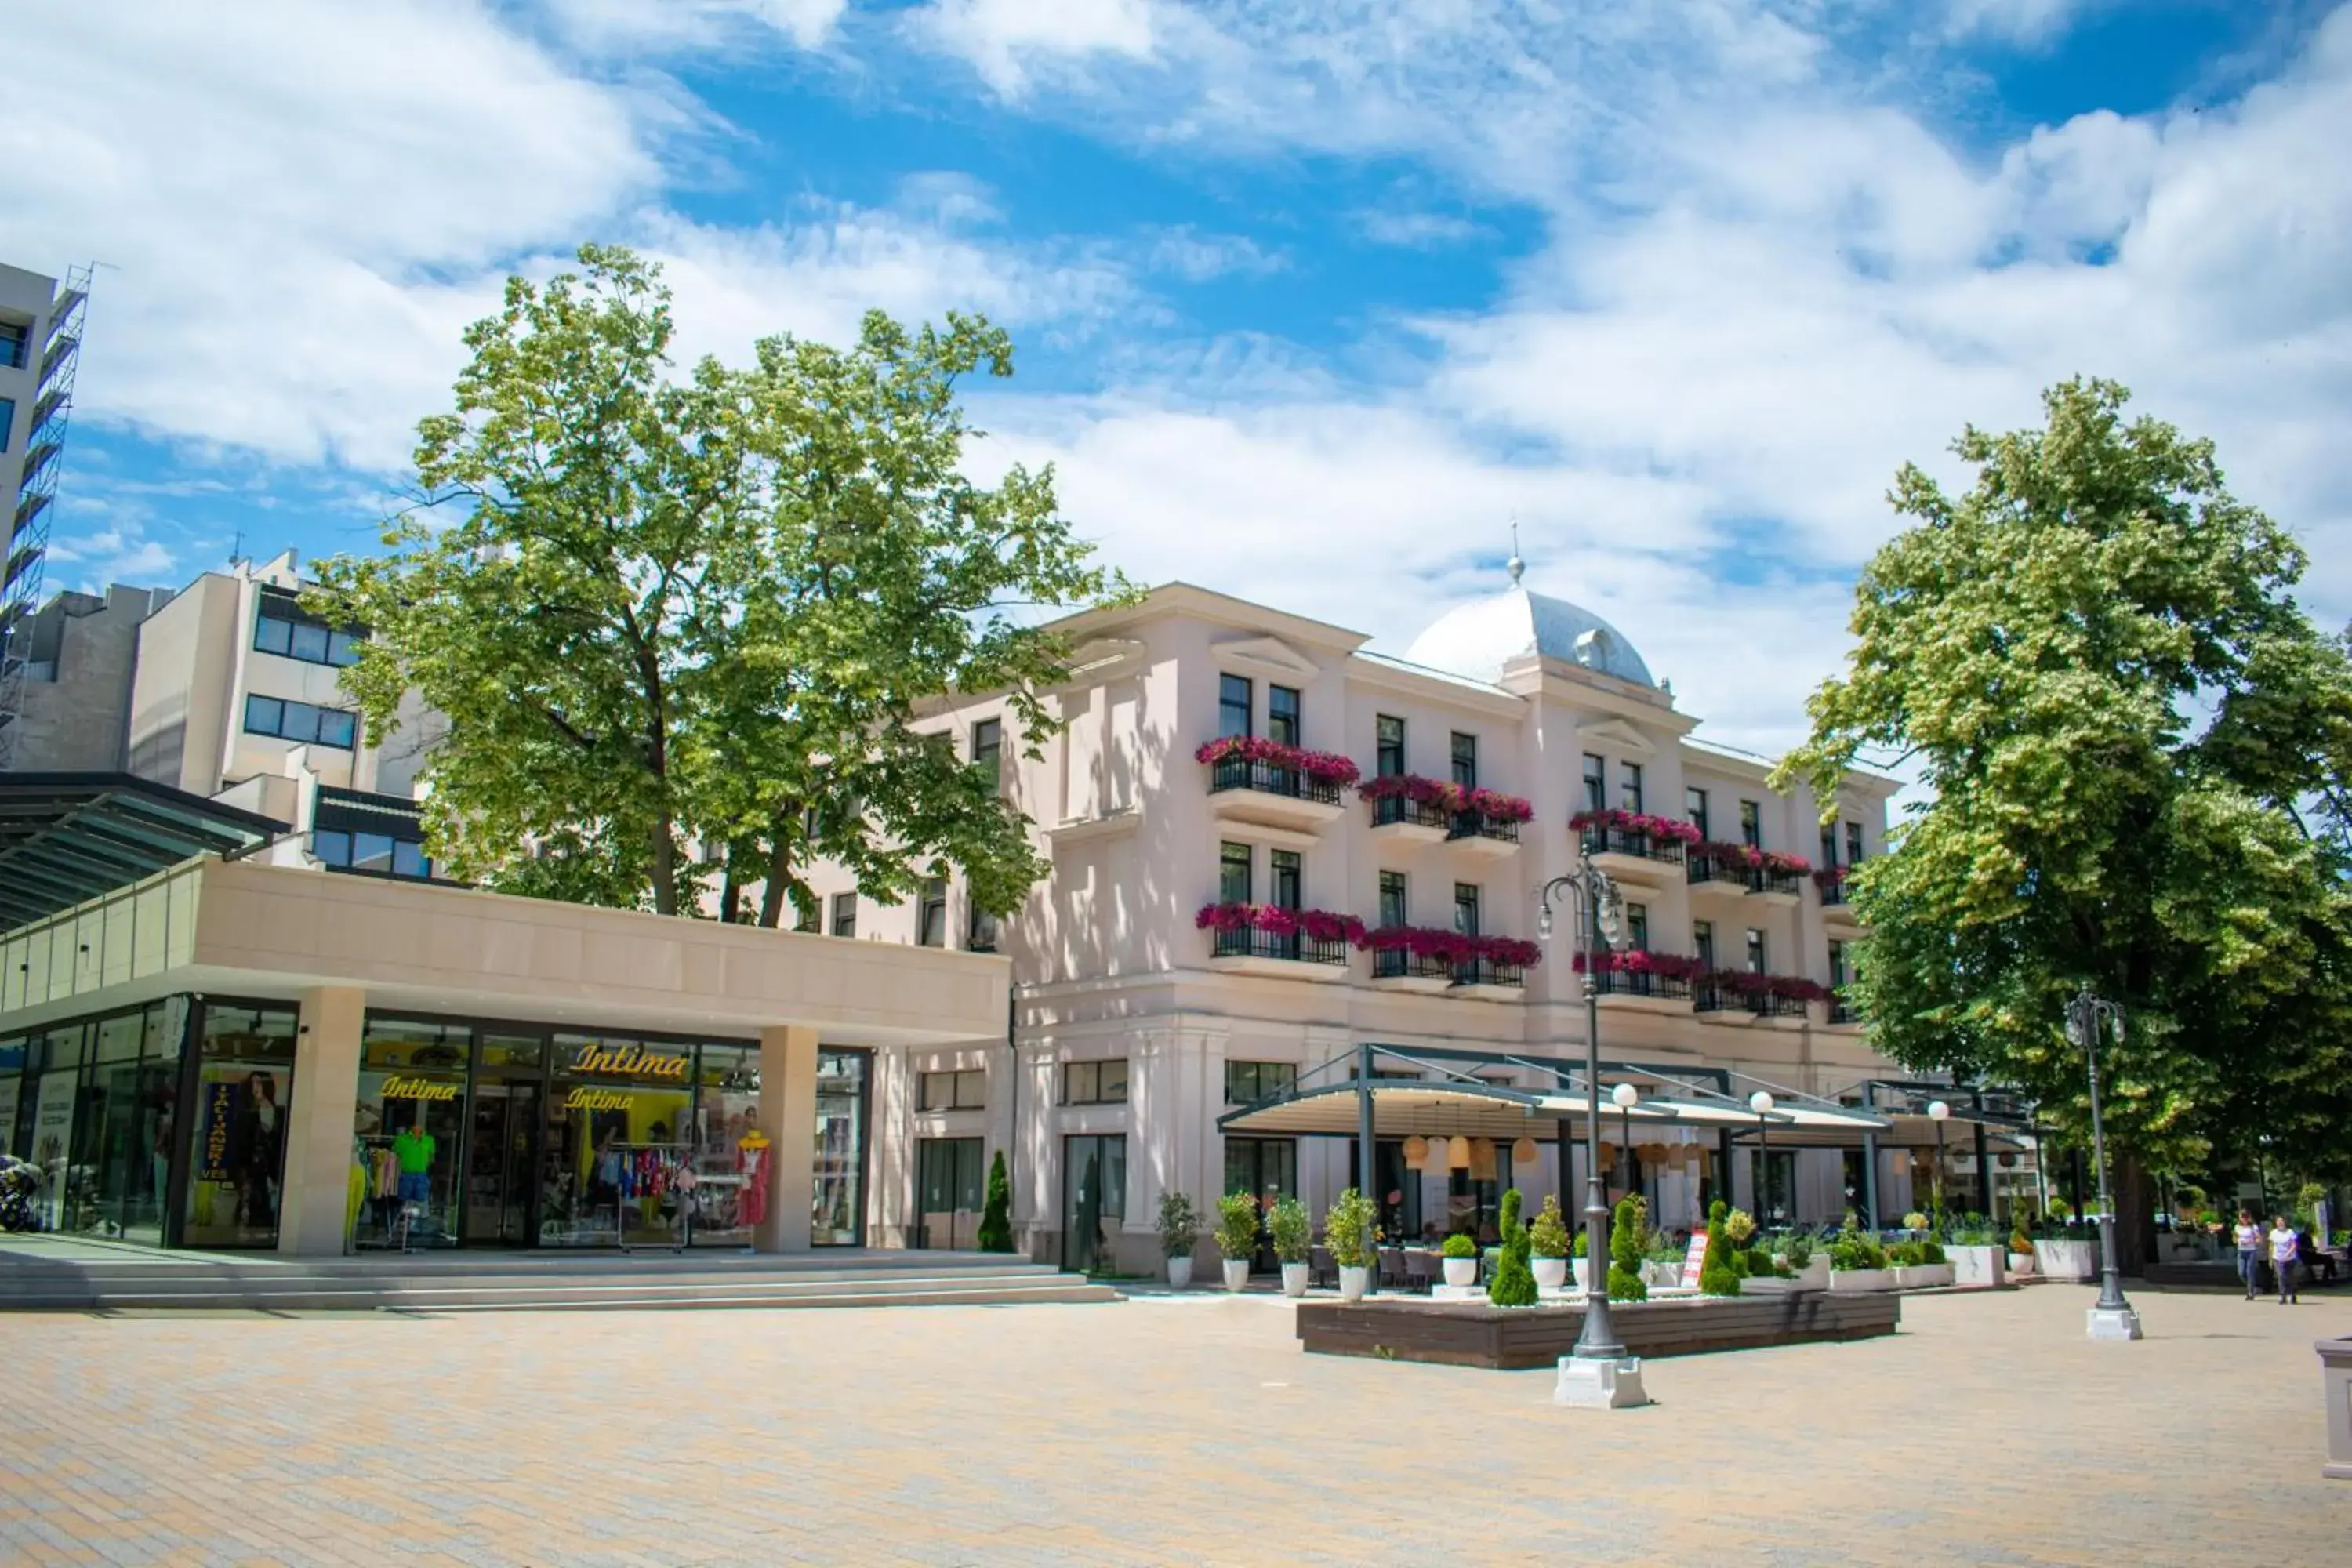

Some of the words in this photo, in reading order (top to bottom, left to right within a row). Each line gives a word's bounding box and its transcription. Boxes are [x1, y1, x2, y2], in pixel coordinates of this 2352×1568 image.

[569, 1045, 688, 1076] Intima
[379, 1076, 458, 1101] Intima
[564, 1087, 633, 1111] Intima
